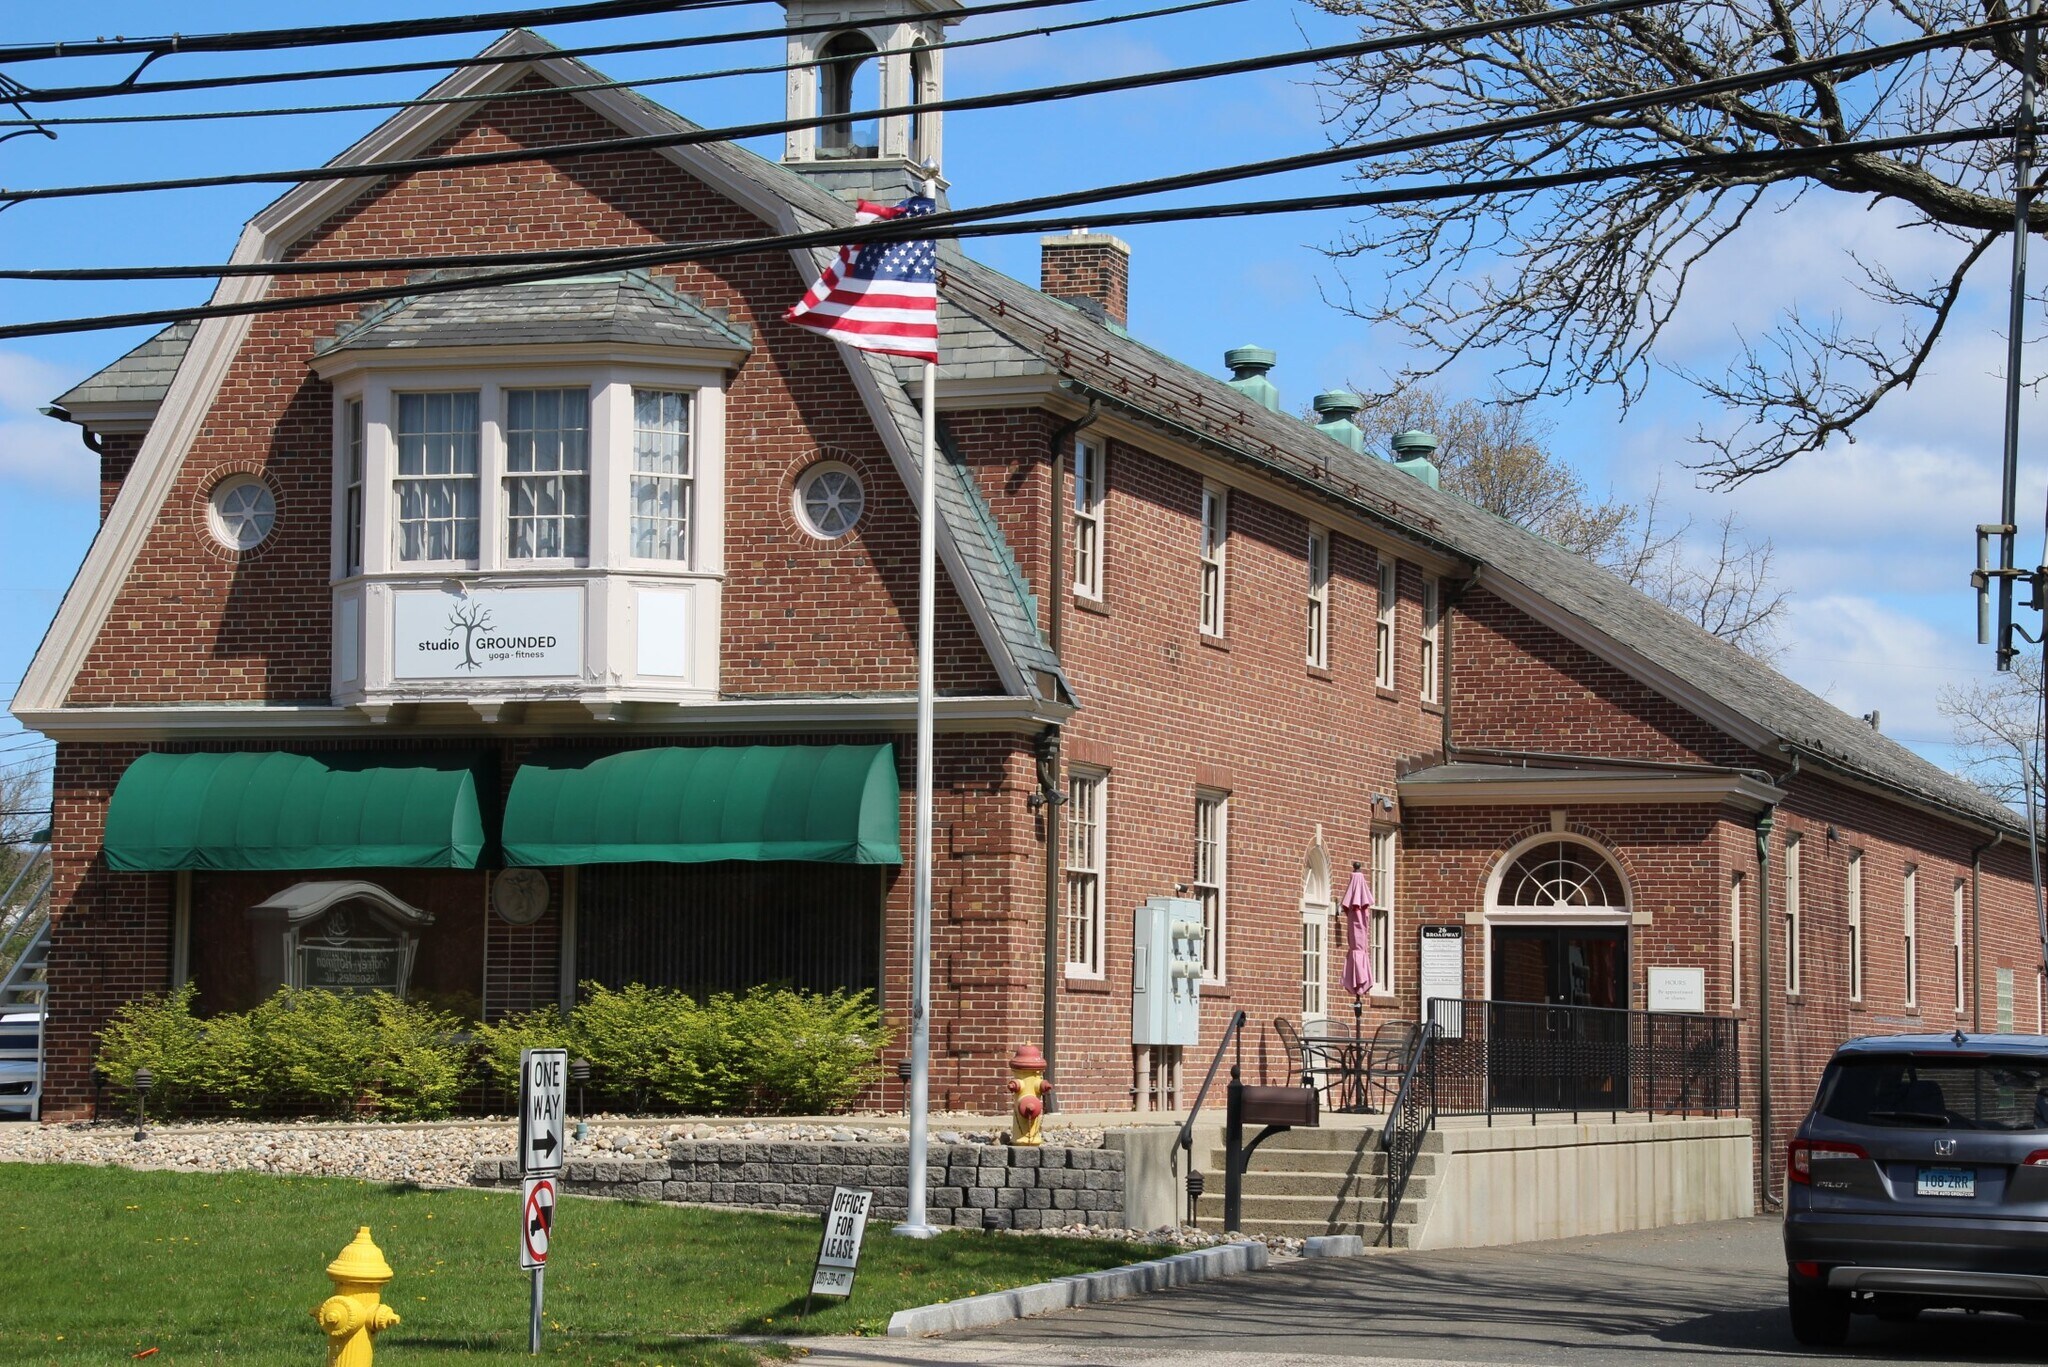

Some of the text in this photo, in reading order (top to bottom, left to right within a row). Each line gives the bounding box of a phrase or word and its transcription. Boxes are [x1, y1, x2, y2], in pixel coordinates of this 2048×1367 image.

[418, 636, 557, 651] studio GROUNDED
[488, 652, 510, 661] yoga
[515, 650, 545, 659] fitness
[535, 1061, 560, 1087] ONE
[533, 1094, 561, 1120] WAY
[1816, 1181, 1851, 1189] PILOT
[834, 1192, 866, 1214] OFFICE
[835, 1216, 854, 1236] FOR
[825, 1237, 855, 1259] LEASE
